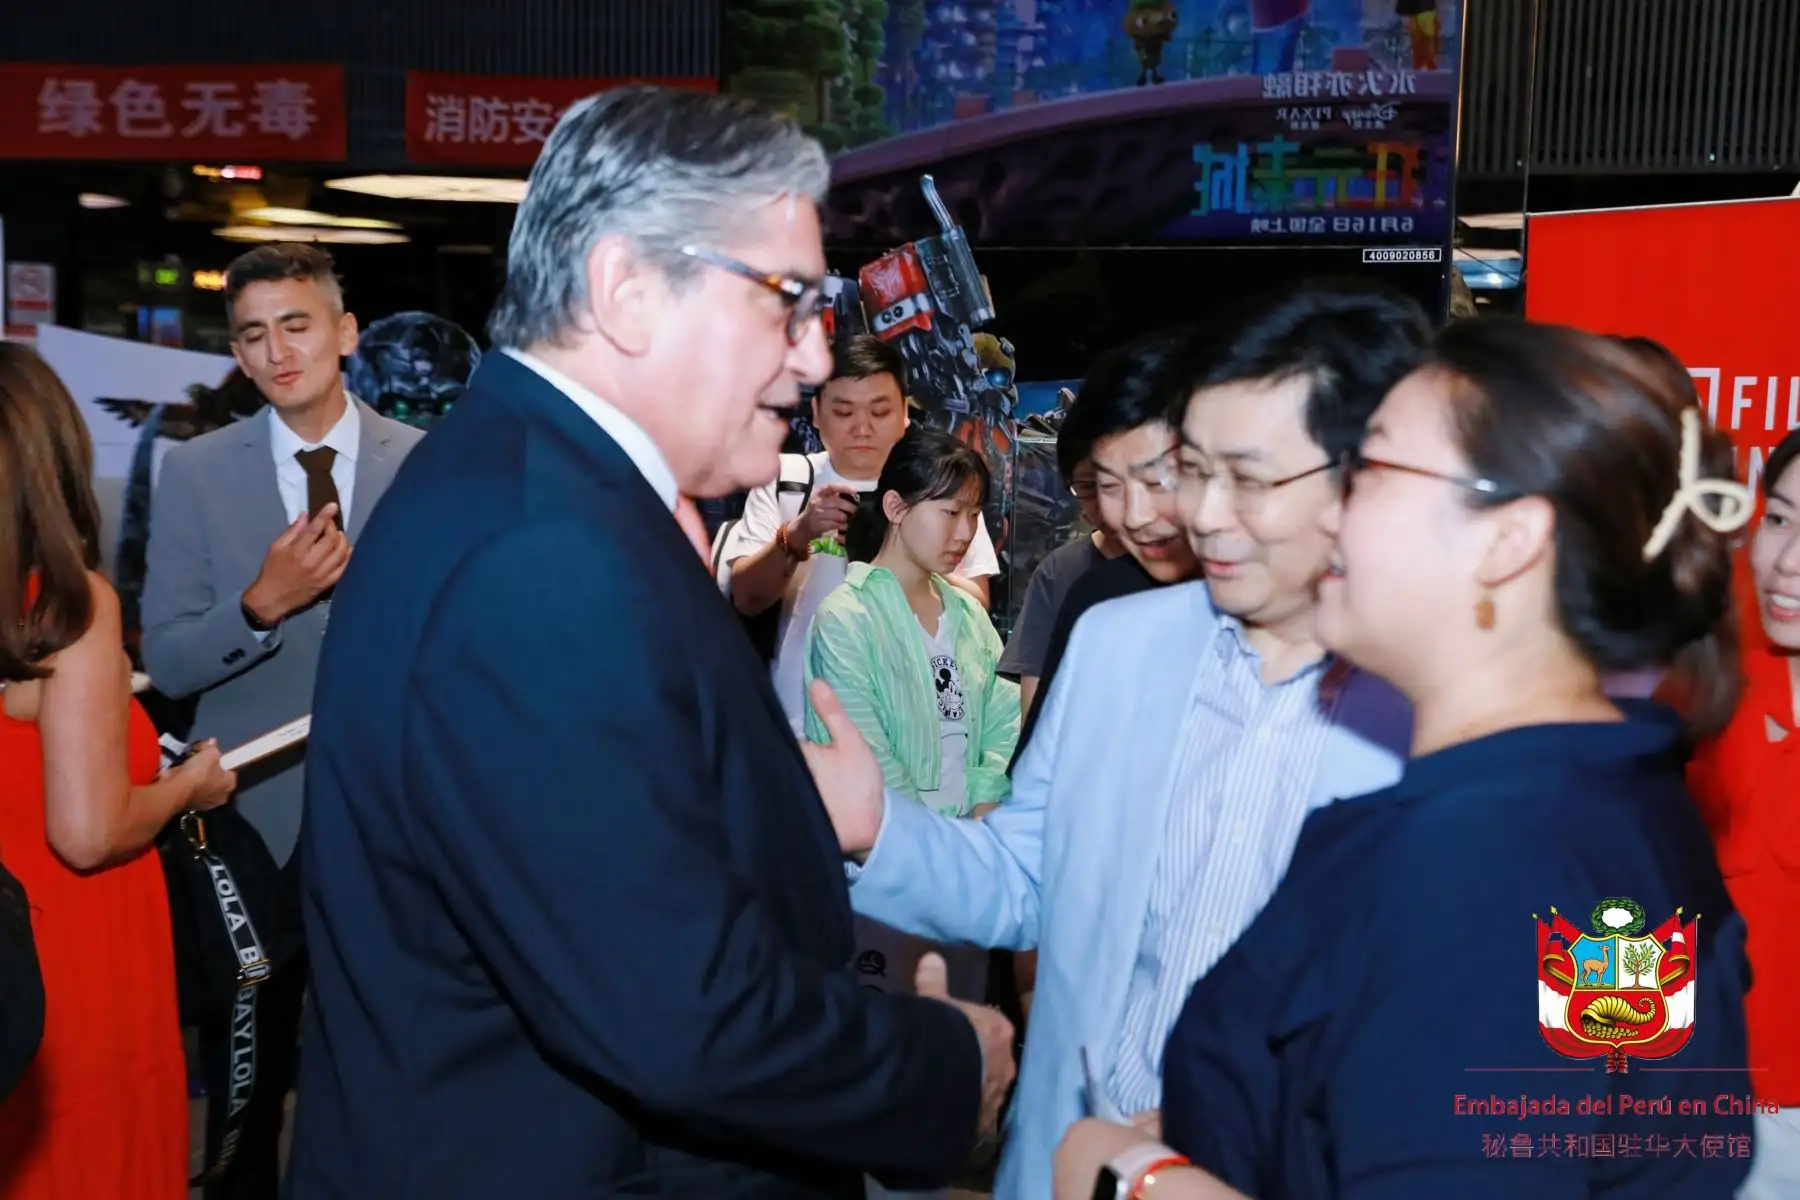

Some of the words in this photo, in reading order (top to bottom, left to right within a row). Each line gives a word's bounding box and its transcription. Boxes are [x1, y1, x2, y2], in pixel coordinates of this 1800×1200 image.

[37, 77, 318, 140] 绿色无毒
[424, 93, 564, 144] 消防安
[1369, 250, 1435, 261] 4009020856
[210, 865, 247, 932] LOLA
